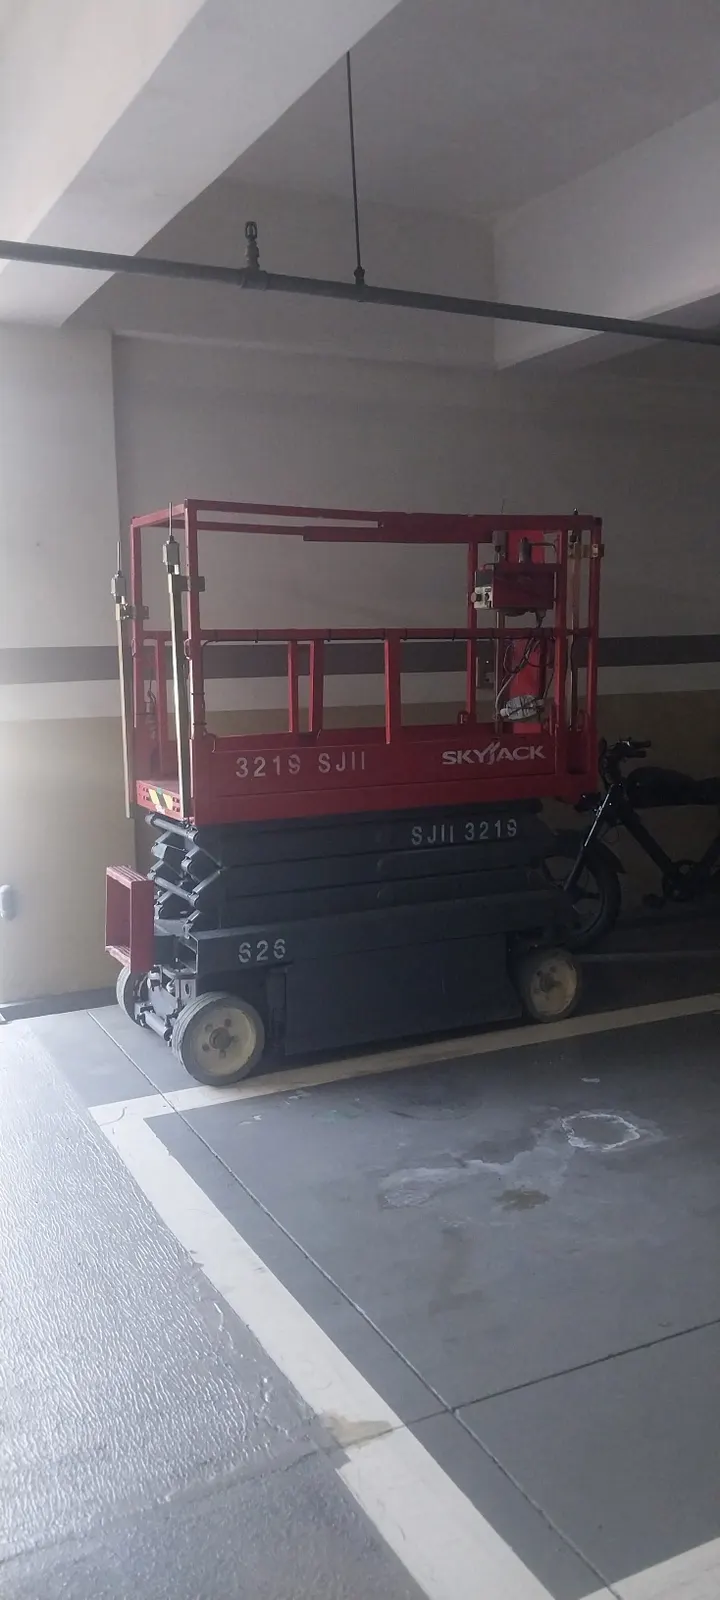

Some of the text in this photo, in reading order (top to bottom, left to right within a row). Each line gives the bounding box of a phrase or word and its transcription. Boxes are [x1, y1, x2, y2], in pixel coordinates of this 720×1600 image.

[441, 741, 546, 765] SKYJACK
[235, 754, 301, 778] 3219
[464, 818, 517, 841] 3219
